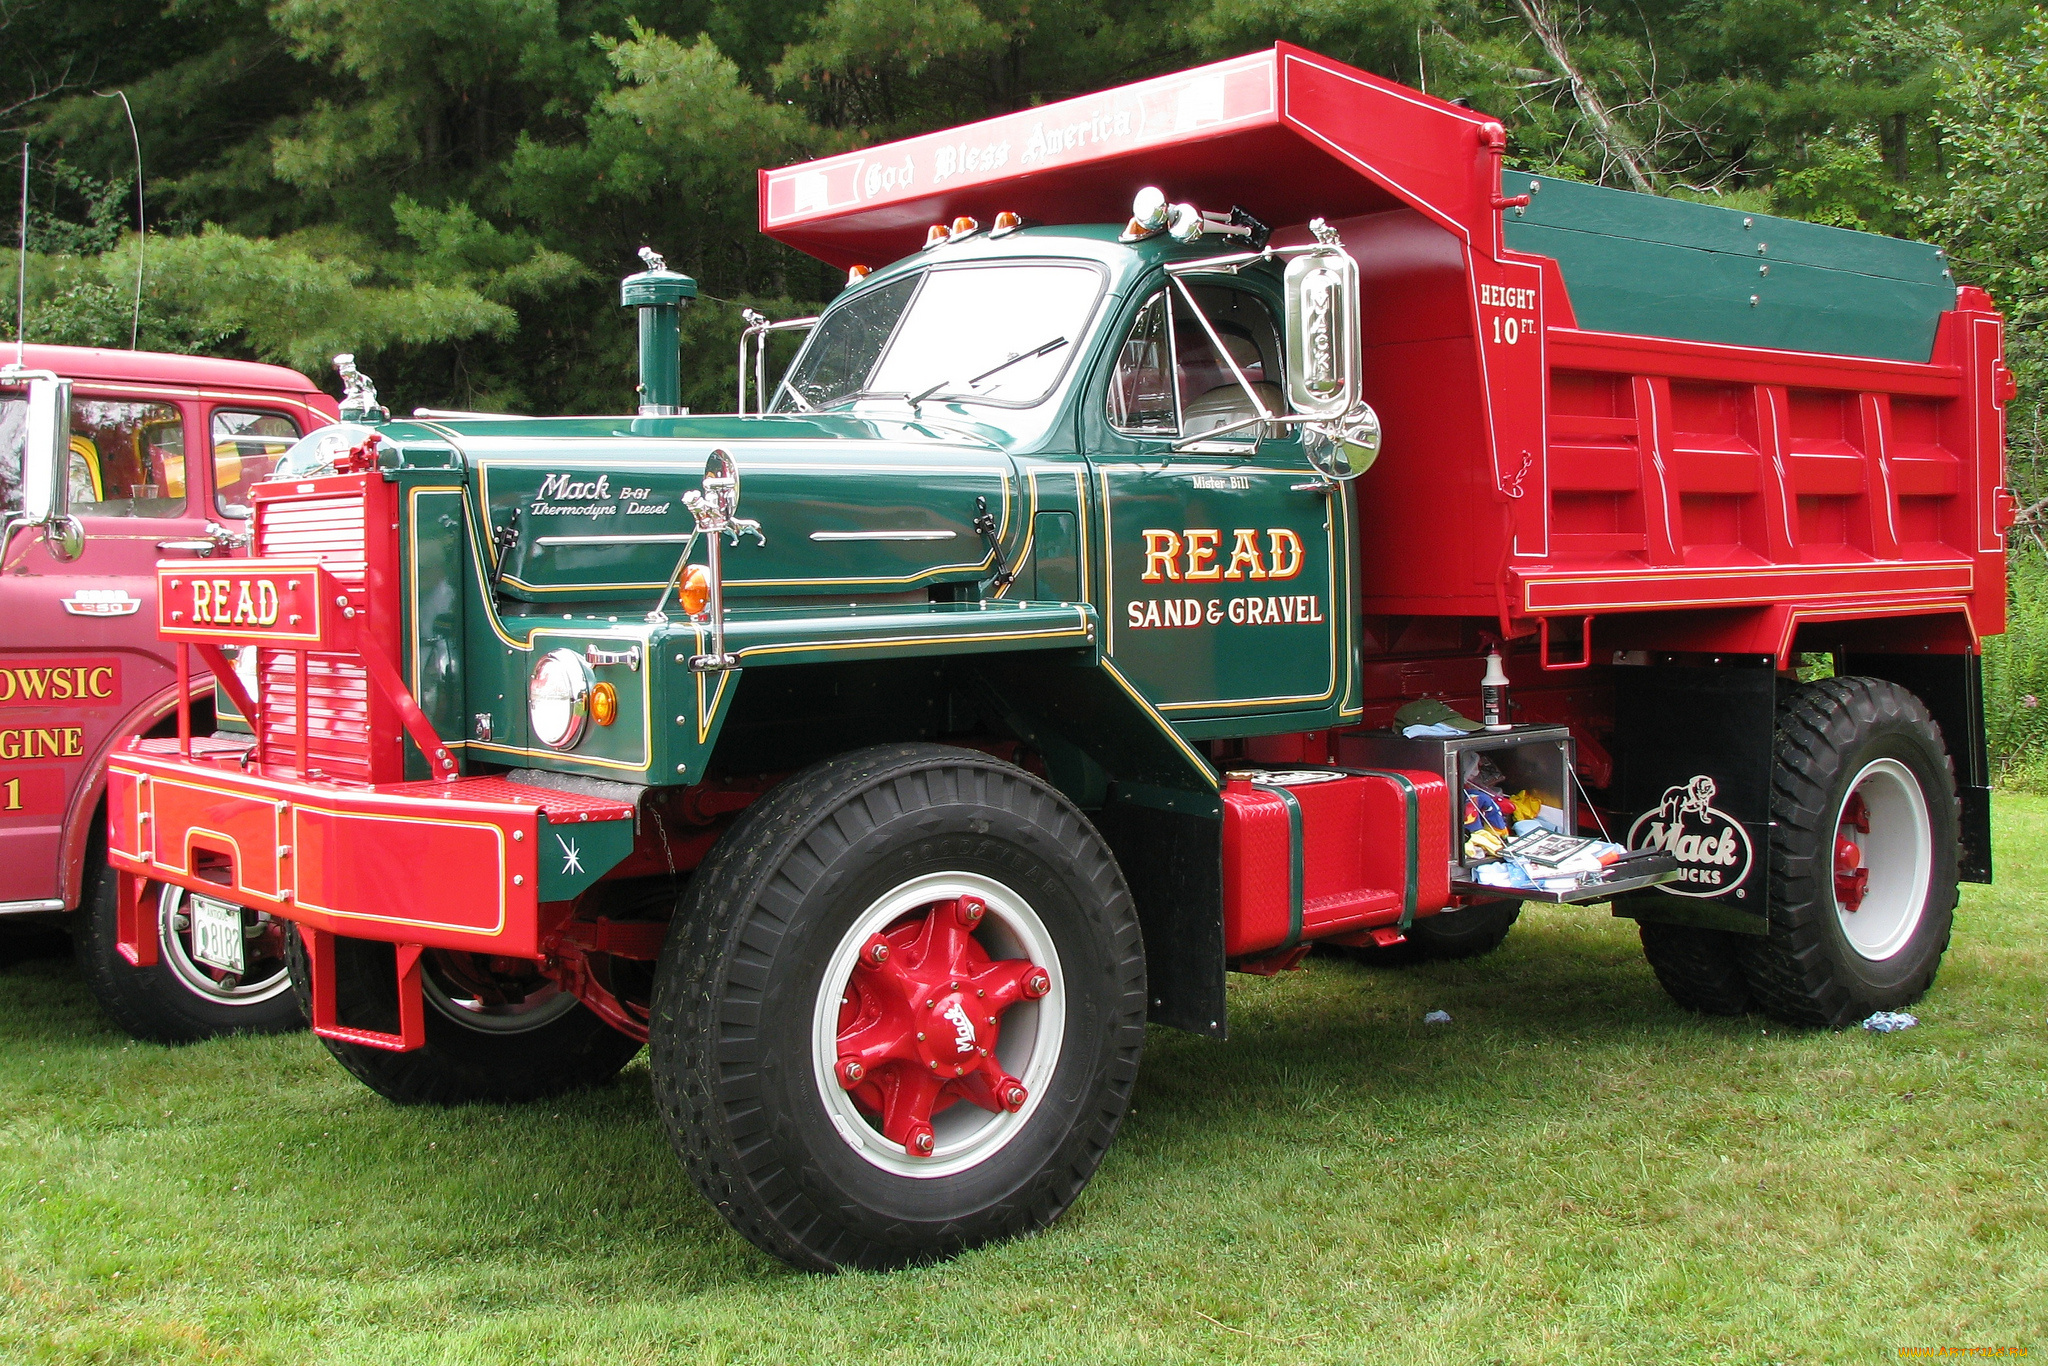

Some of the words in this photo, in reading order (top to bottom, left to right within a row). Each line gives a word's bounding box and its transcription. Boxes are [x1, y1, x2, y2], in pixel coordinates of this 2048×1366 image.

[864, 154, 914, 198] God
[933, 139, 1012, 184] Bless
[1021, 110, 1132, 165] America
[1480, 284, 1536, 310] HEIGHT
[1493, 316, 1518, 345] 10
[1521, 319, 1537, 334] FT.
[535, 473, 611, 500] Mack
[1192, 475, 1226, 489] Mister
[1230, 476, 1250, 489] Bill
[530, 502, 617, 520] Thermodyne
[626, 502, 670, 514] Diesel
[1141, 528, 1305, 583] READ
[191, 579, 279, 628] READ
[1128, 599, 1204, 628] SAND
[1206, 599, 1225, 625] &
[1228, 596, 1324, 625] GRAVEL
[0, 727, 84, 760] GINE
[3, 778, 23, 811] 1
[1641, 822, 1736, 865] Mack
[1677, 867, 1721, 885] UCKS
[944, 1003, 976, 1053] Mack
